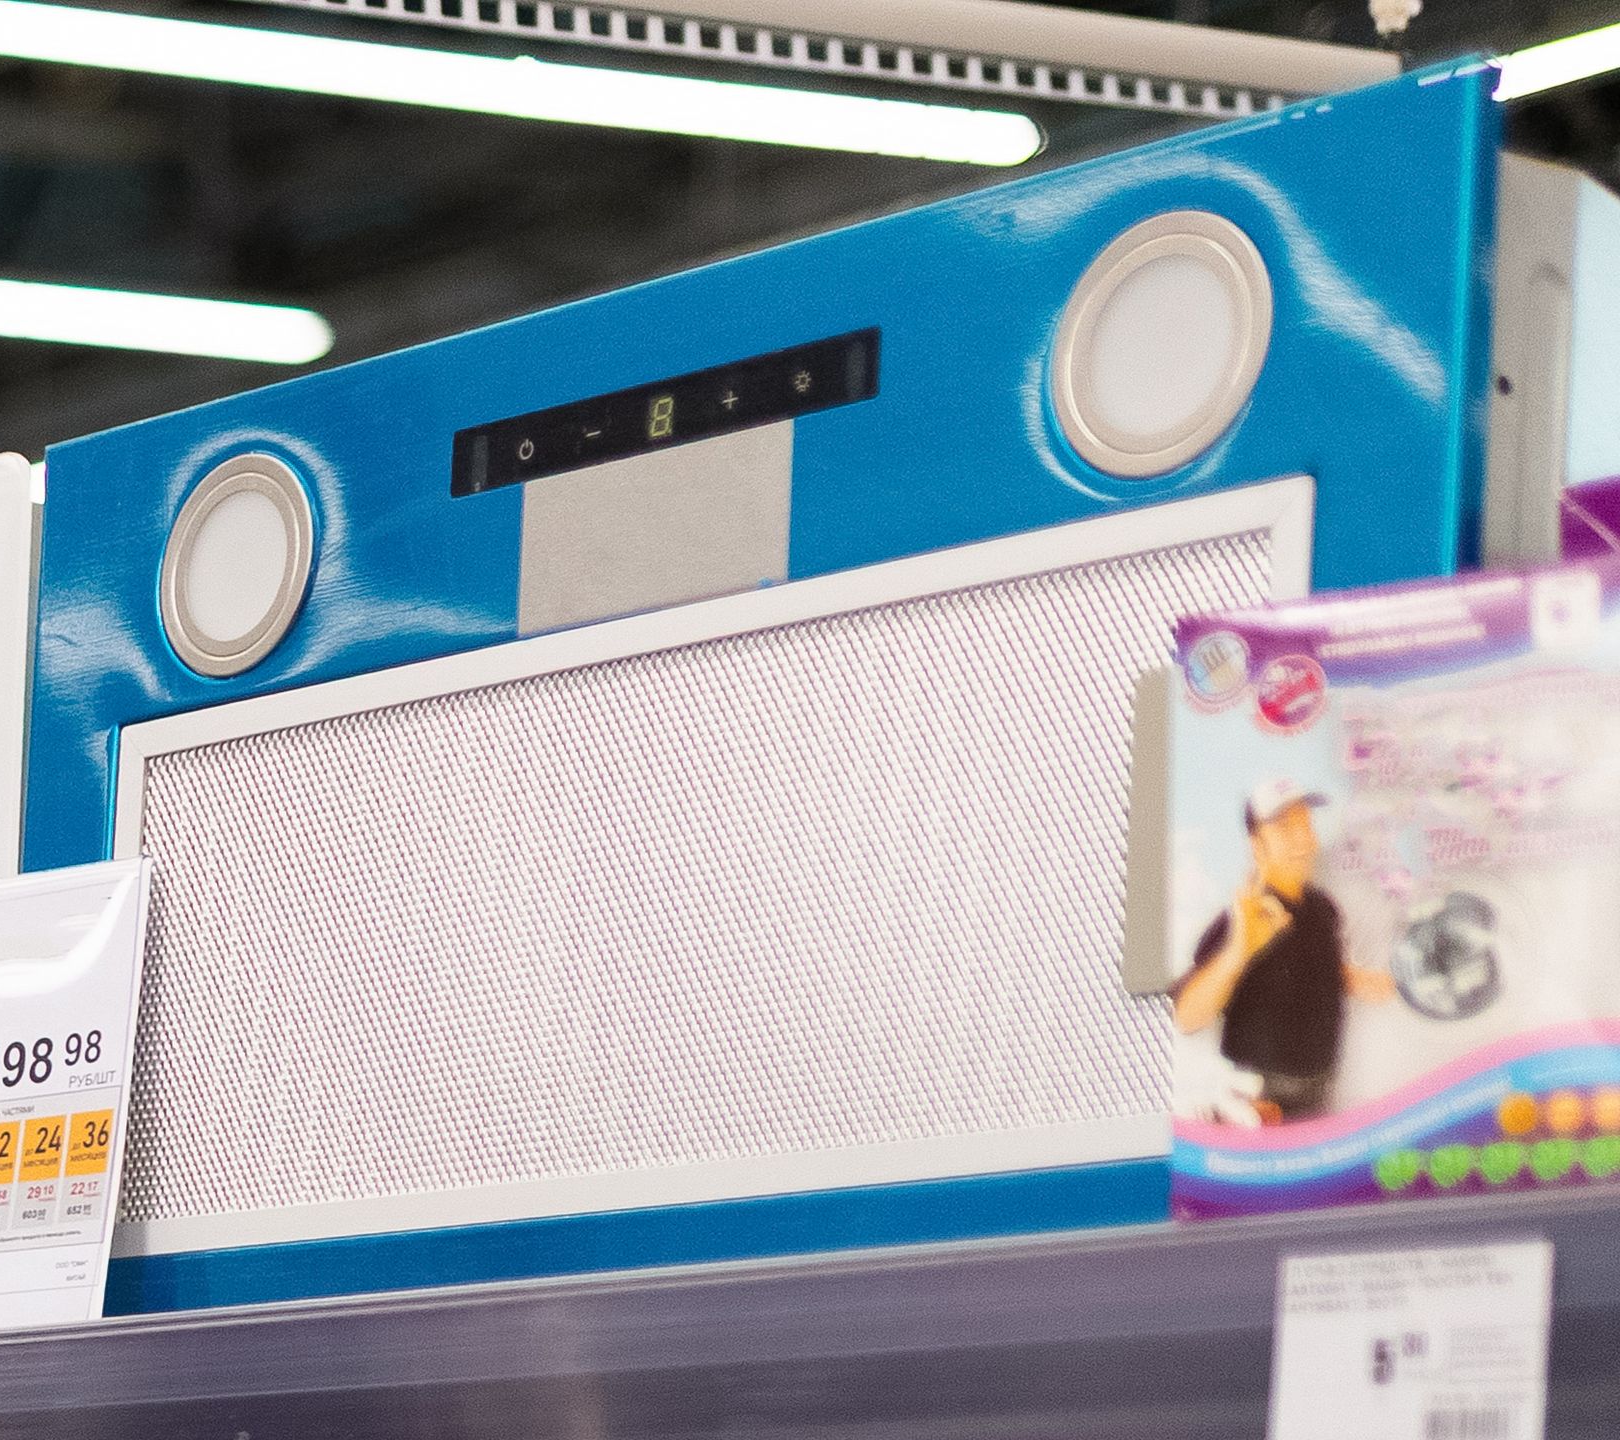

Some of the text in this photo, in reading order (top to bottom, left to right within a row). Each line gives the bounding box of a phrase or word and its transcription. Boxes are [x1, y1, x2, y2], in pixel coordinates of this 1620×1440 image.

[64, 1029, 103, 1067] 98
[68, 1070, 117, 1089] РУБ/ШТ
[35, 1124, 61, 1155] 24
[83, 1119, 109, 1149] 36
[71, 1182, 85, 1196] 22
